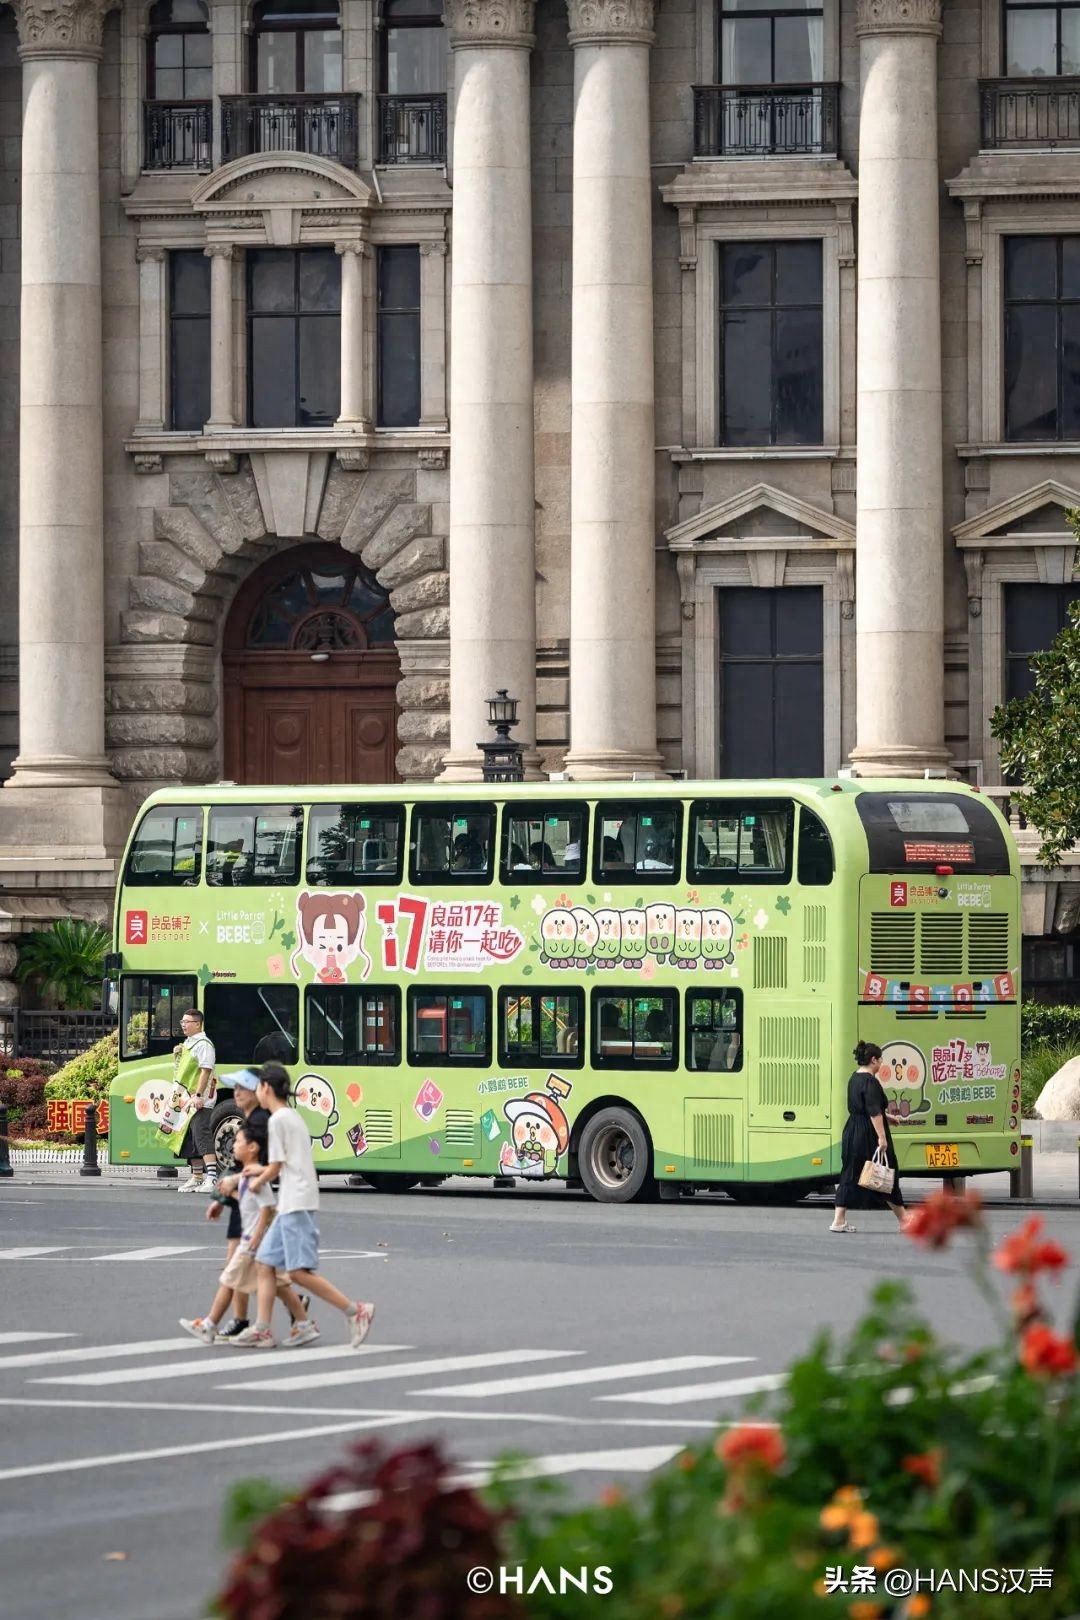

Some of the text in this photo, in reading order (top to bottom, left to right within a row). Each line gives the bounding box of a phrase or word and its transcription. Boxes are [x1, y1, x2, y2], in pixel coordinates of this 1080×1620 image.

[151, 915, 191, 931] 良品铺子
[216, 910, 264, 920] Little Parrot
[431, 905, 500, 927] 良品17年
[216, 925, 250, 943] BEBE
[429, 930, 520, 955] 请你一起吃
[868, 977, 1010, 1008] BESTORE
[933, 1040, 973, 1062] 良品17岁
[932, 1062, 974, 1082] 吃在一起
[507, 1077, 528, 1089] BEBE
[973, 1086, 996, 1100] BEBE
[929, 1152, 958, 1166] AF215
